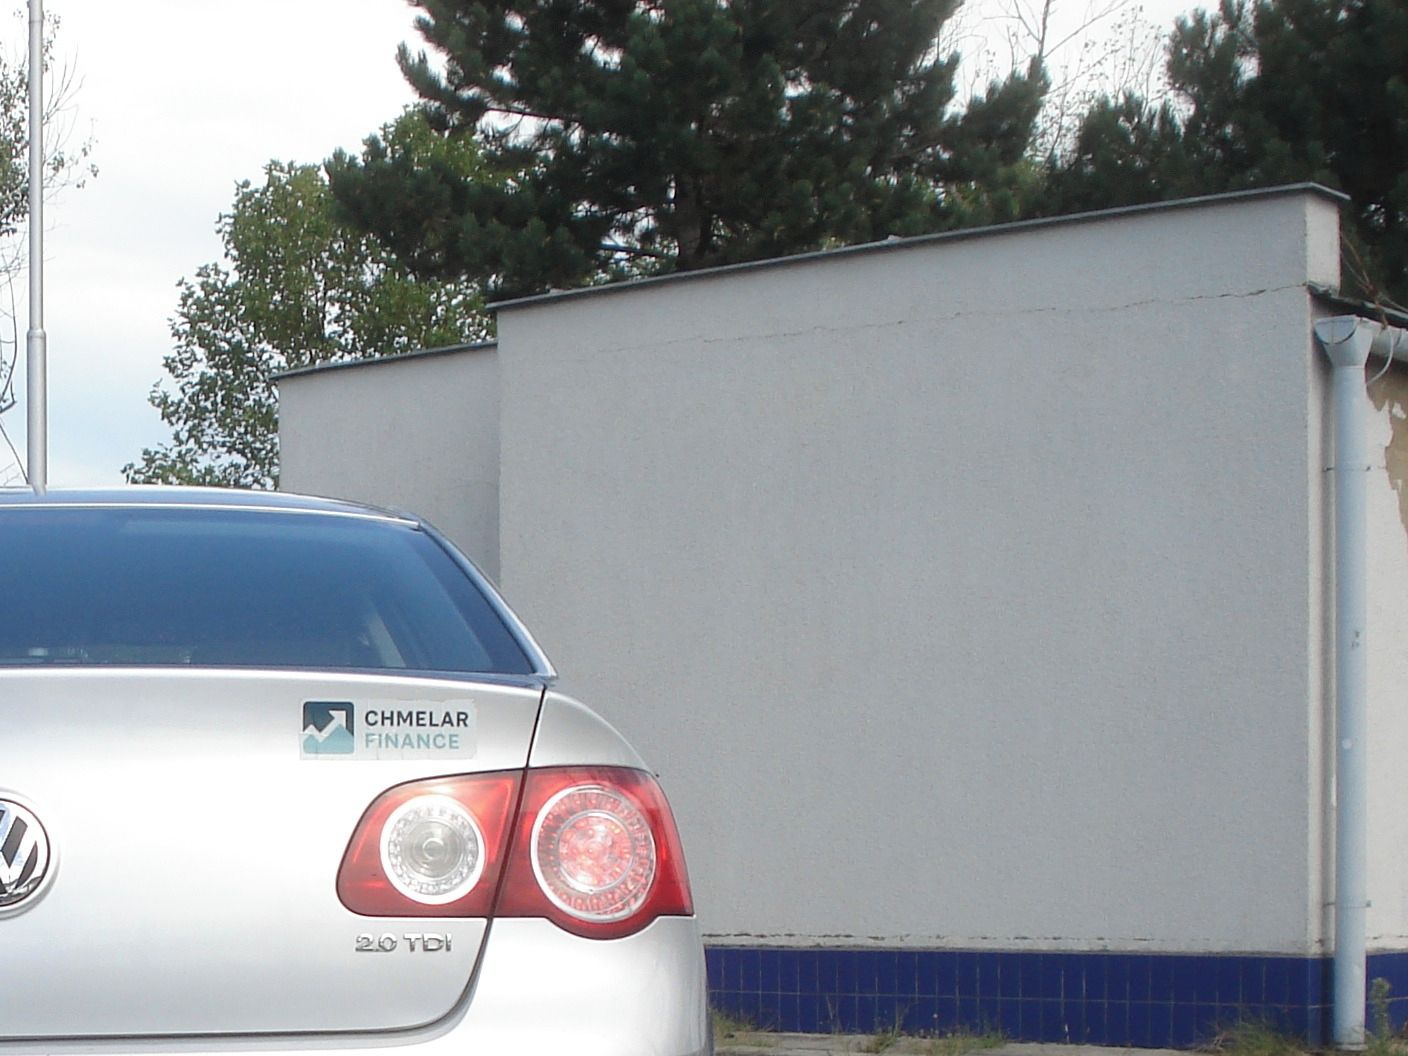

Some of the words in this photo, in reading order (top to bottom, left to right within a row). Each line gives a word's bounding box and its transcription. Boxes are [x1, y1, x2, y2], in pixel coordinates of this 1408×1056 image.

[364, 709, 469, 728] CHMELAR
[364, 732, 460, 750] FINANCE
[403, 933, 452, 953] TDI
